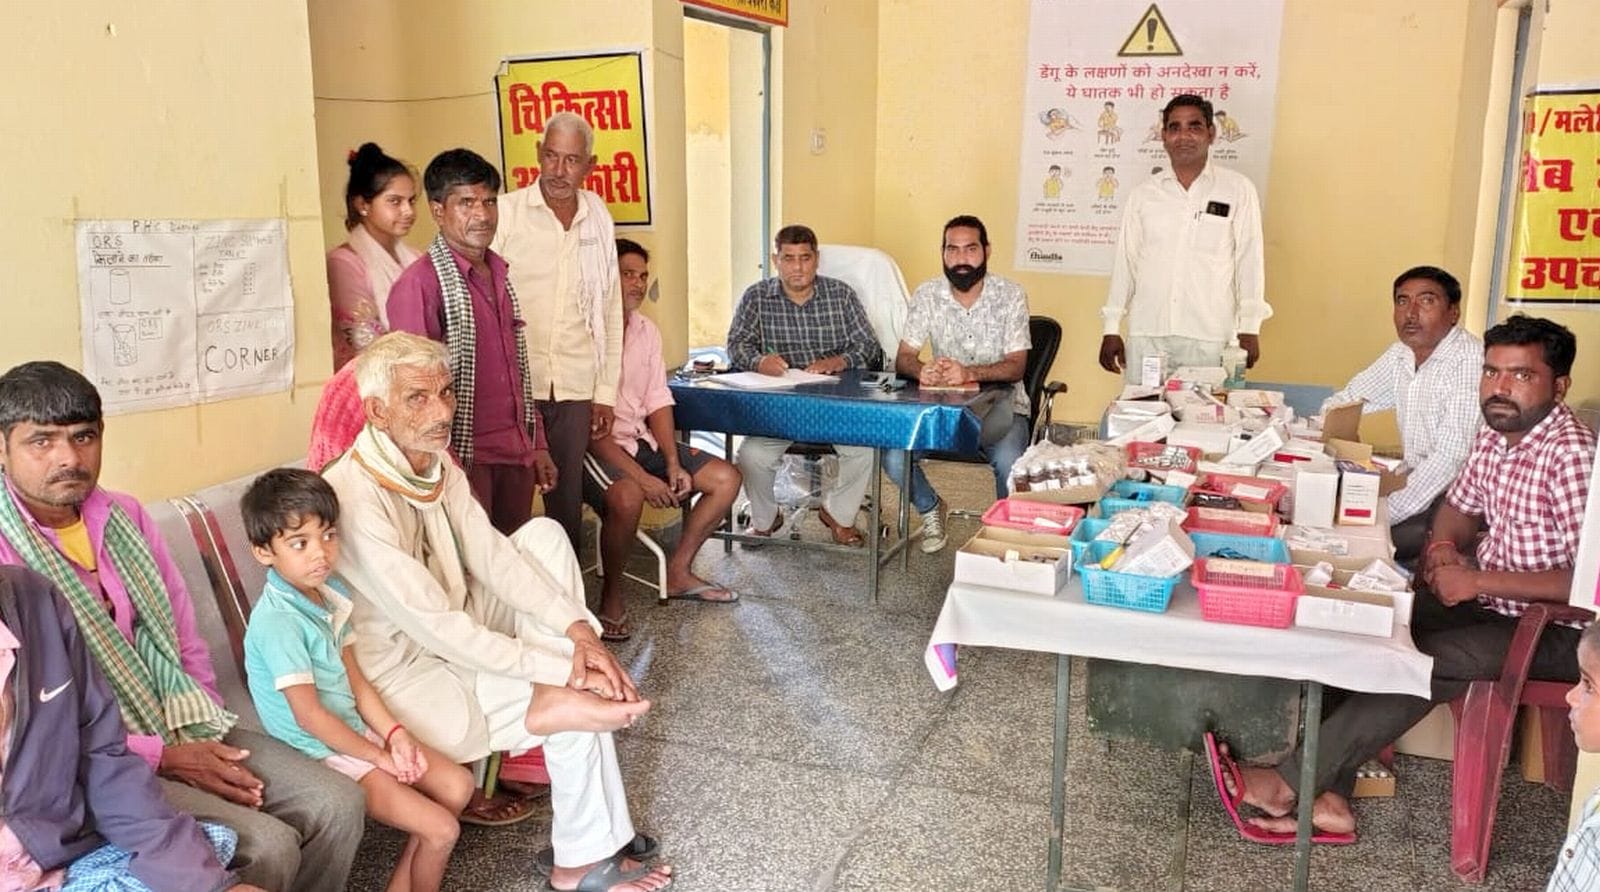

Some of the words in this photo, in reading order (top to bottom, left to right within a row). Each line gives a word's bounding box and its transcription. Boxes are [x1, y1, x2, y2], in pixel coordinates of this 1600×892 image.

[1039, 63, 1062, 82] डेंगू
[1065, 63, 1079, 79] के
[1083, 62, 1127, 79] लक्षणों
[1132, 63, 1151, 79] को
[1156, 63, 1212, 79] अनदेखा
[1217, 66, 1230, 78] न
[1066, 86, 1076, 99] ये
[1082, 87, 1122, 99] घातक
[1128, 84, 1145, 99] भी
[1151, 84, 1165, 99] हो
[1218, 84, 1231, 99] है
